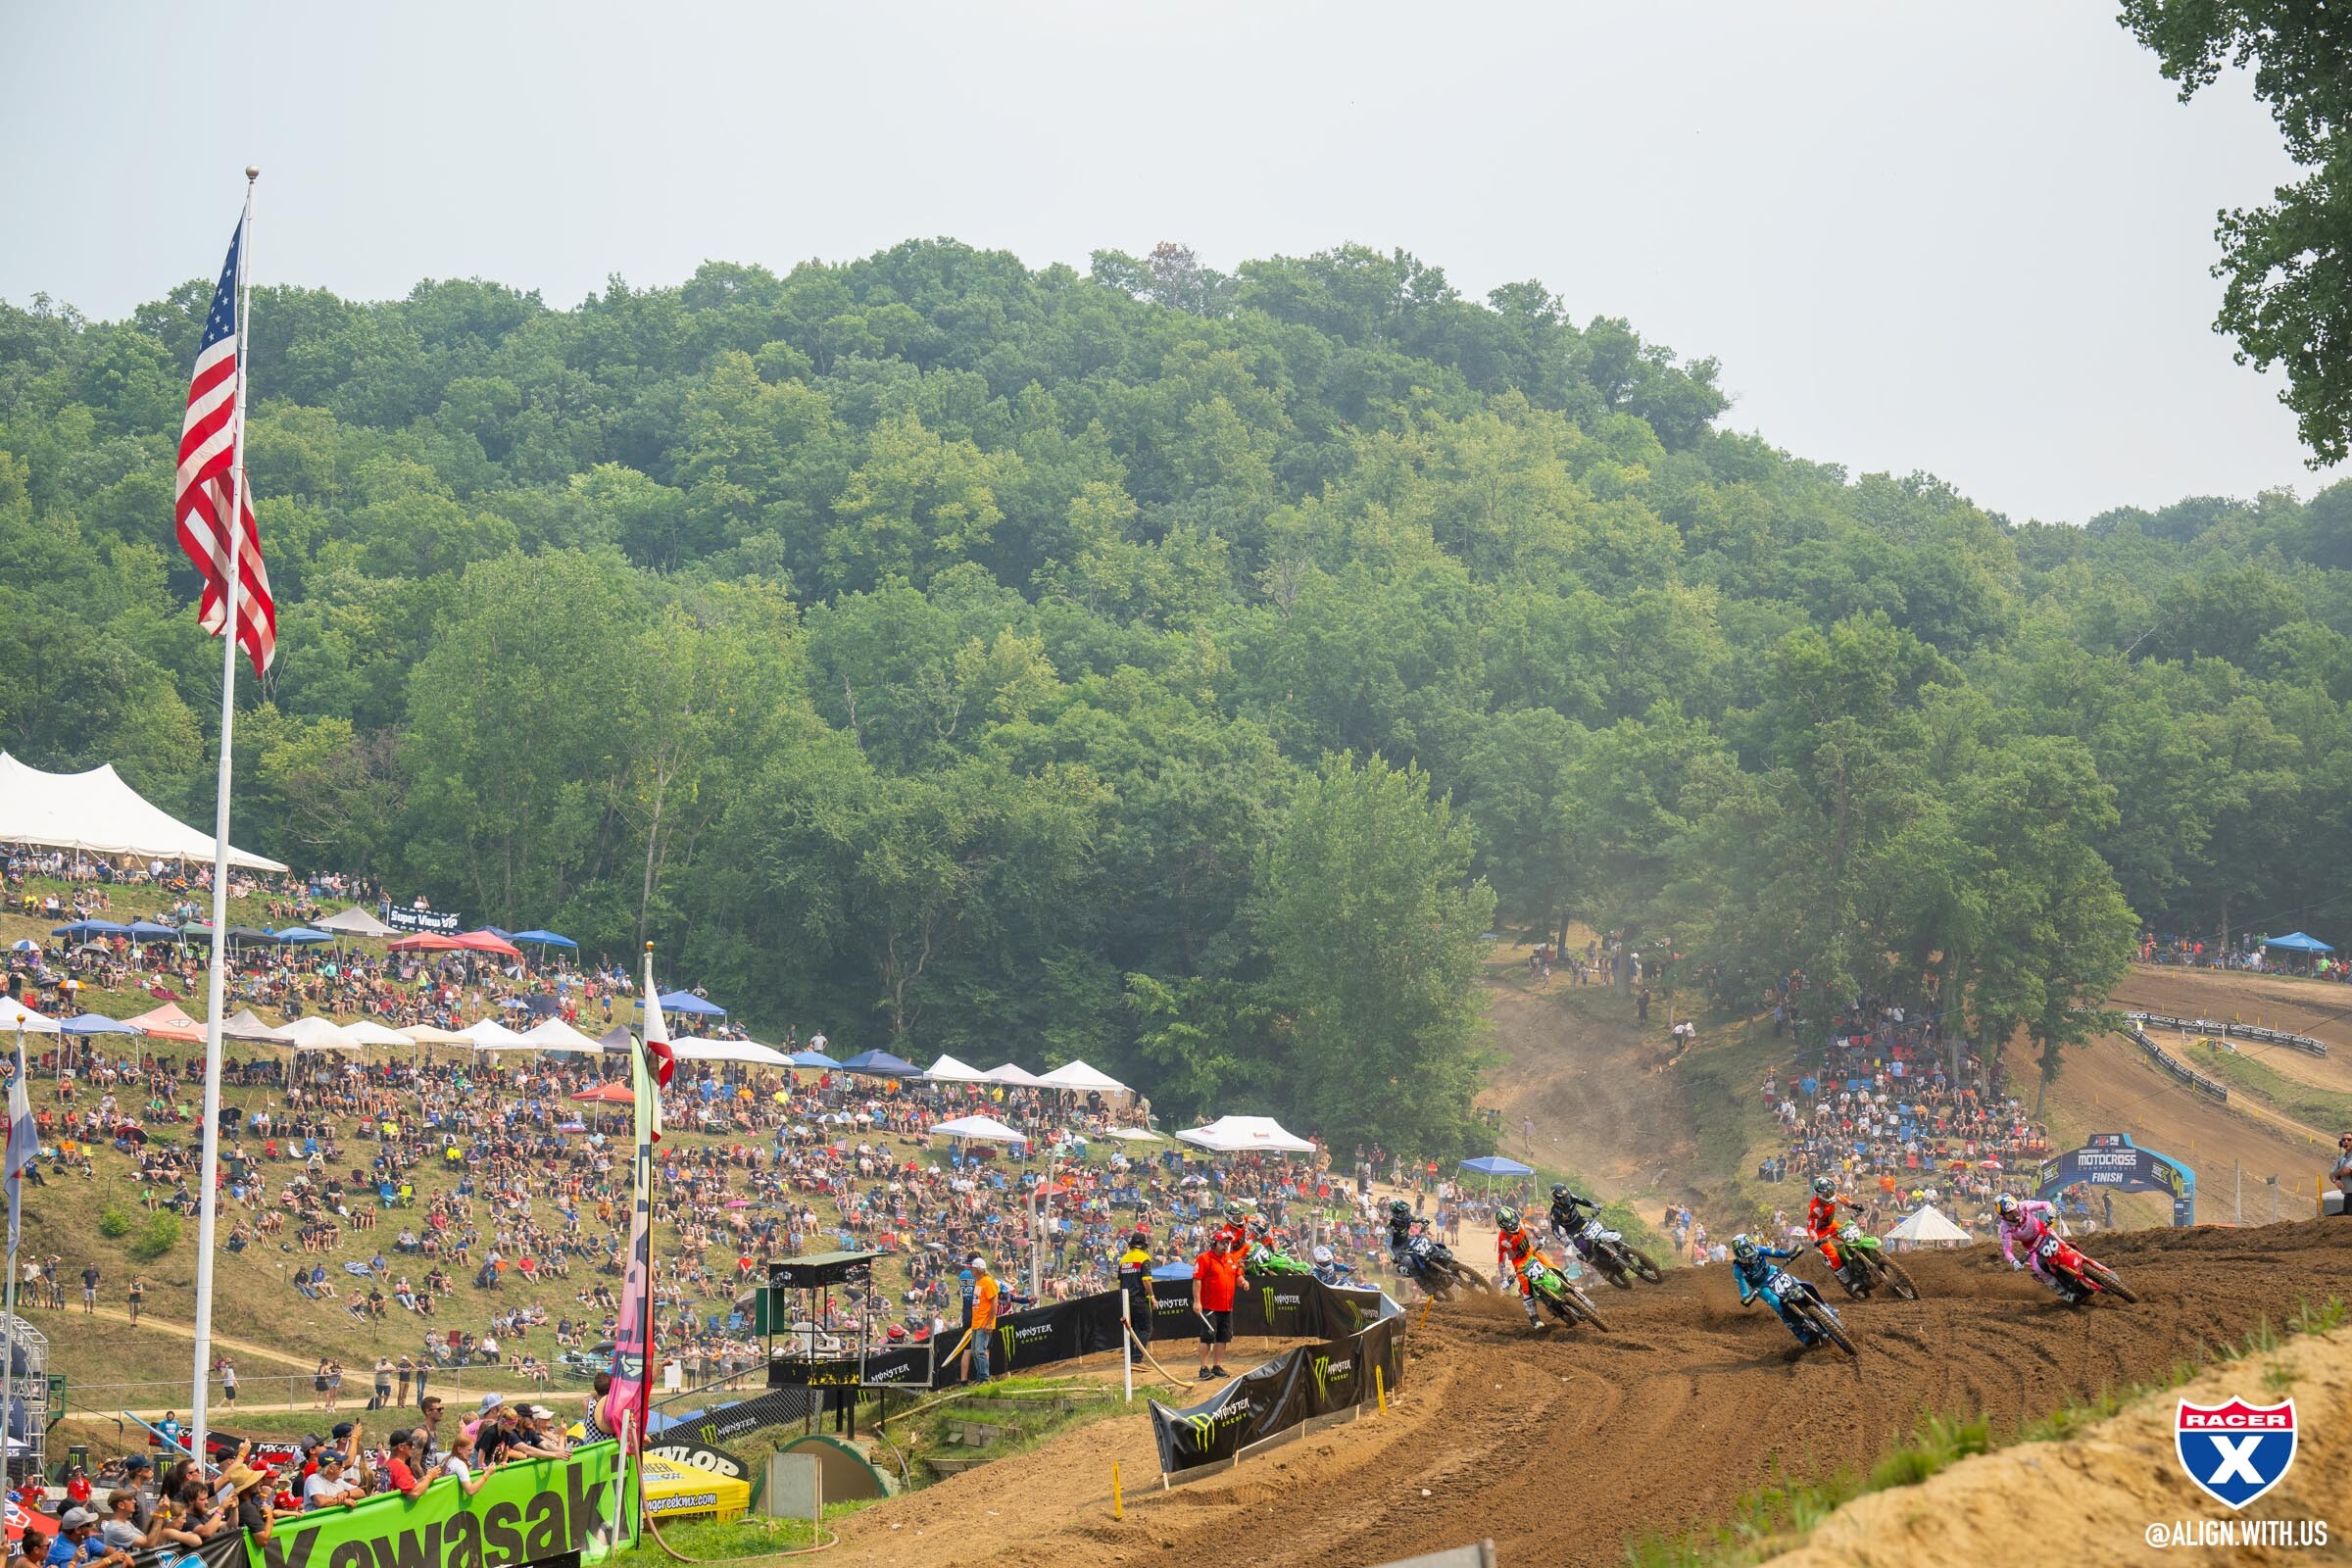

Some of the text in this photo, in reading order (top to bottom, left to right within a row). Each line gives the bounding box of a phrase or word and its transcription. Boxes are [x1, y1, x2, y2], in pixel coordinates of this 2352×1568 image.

[391, 910, 417, 924] Super
[417, 914, 441, 927] View
[2079, 1154, 2136, 1166] MOTOCROSS
[2092, 1172, 2124, 1183] FINISH
[1414, 1238, 1432, 1255] 32
[2040, 1239, 2059, 1257] 96
[1527, 1261, 1544, 1281] 30
[1774, 1274, 1792, 1295] 43
[1274, 1294, 1300, 1304] MONSTER
[1015, 1324, 1053, 1339] MONSTER
[1020, 1335, 1048, 1344] ENERGY
[870, 1363, 910, 1383] MONSTER
[1327, 1359, 1351, 1375] MONSTER
[1212, 1397, 1250, 1420] MONSTER
[717, 1417, 757, 1435] MONSTER
